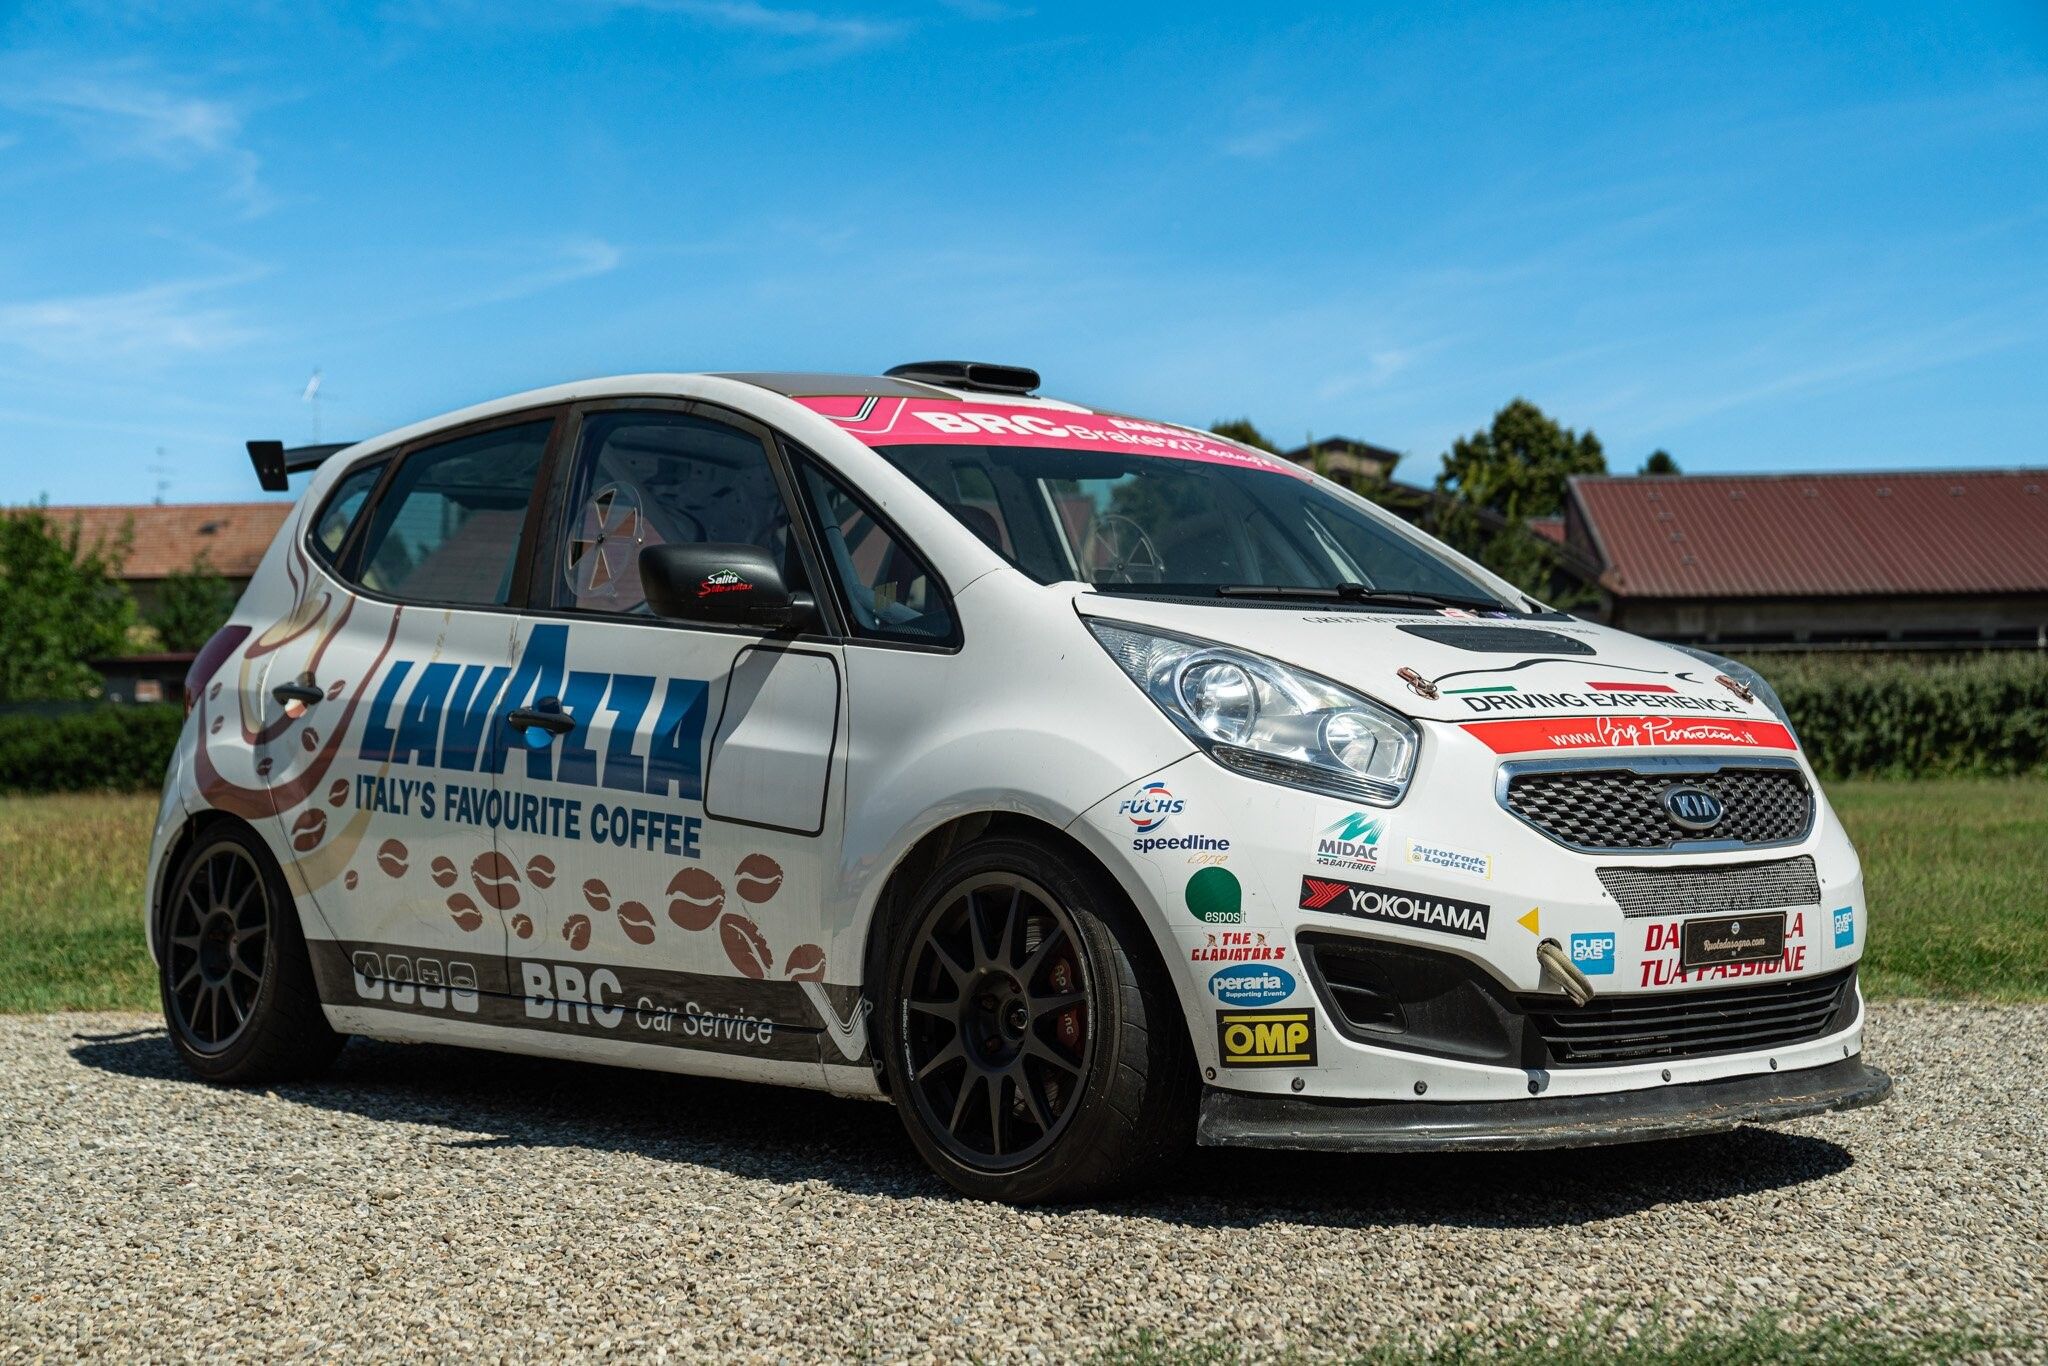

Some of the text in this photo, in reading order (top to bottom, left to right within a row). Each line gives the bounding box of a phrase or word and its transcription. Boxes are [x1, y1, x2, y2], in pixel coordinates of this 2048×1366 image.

[911, 412, 1070, 437] BRC
[707, 574, 738, 585] Salita
[358, 624, 710, 800] LAVAZZA
[1461, 693, 1748, 714] DRIVING EXPERIENCE
[1118, 799, 1184, 815] FUCHS
[1674, 795, 1718, 817] KIA
[355, 774, 702, 860] ITALY'S FAVOURITE COFFEE
[1133, 835, 1231, 853] speedline
[1318, 839, 1378, 861] MIDAC
[1329, 859, 1377, 873] BATTERIES
[1412, 844, 1487, 867] Autotrade
[1424, 853, 1485, 874] Logistics
[1348, 888, 1486, 934] YOKOHAMA
[1222, 932, 1252, 946] THE
[1573, 938, 1613, 950] CUBO
[1703, 937, 1766, 952] Ruotedasogno.com
[1191, 947, 1286, 961] GLADIATORS
[1573, 948, 1603, 960] GAS
[1640, 958, 1687, 988] TUA
[1212, 972, 1281, 999] peraria
[1225, 991, 1262, 999] Supporting
[521, 961, 773, 1044] BRC Car Service
[1224, 1022, 1309, 1054] OMP
